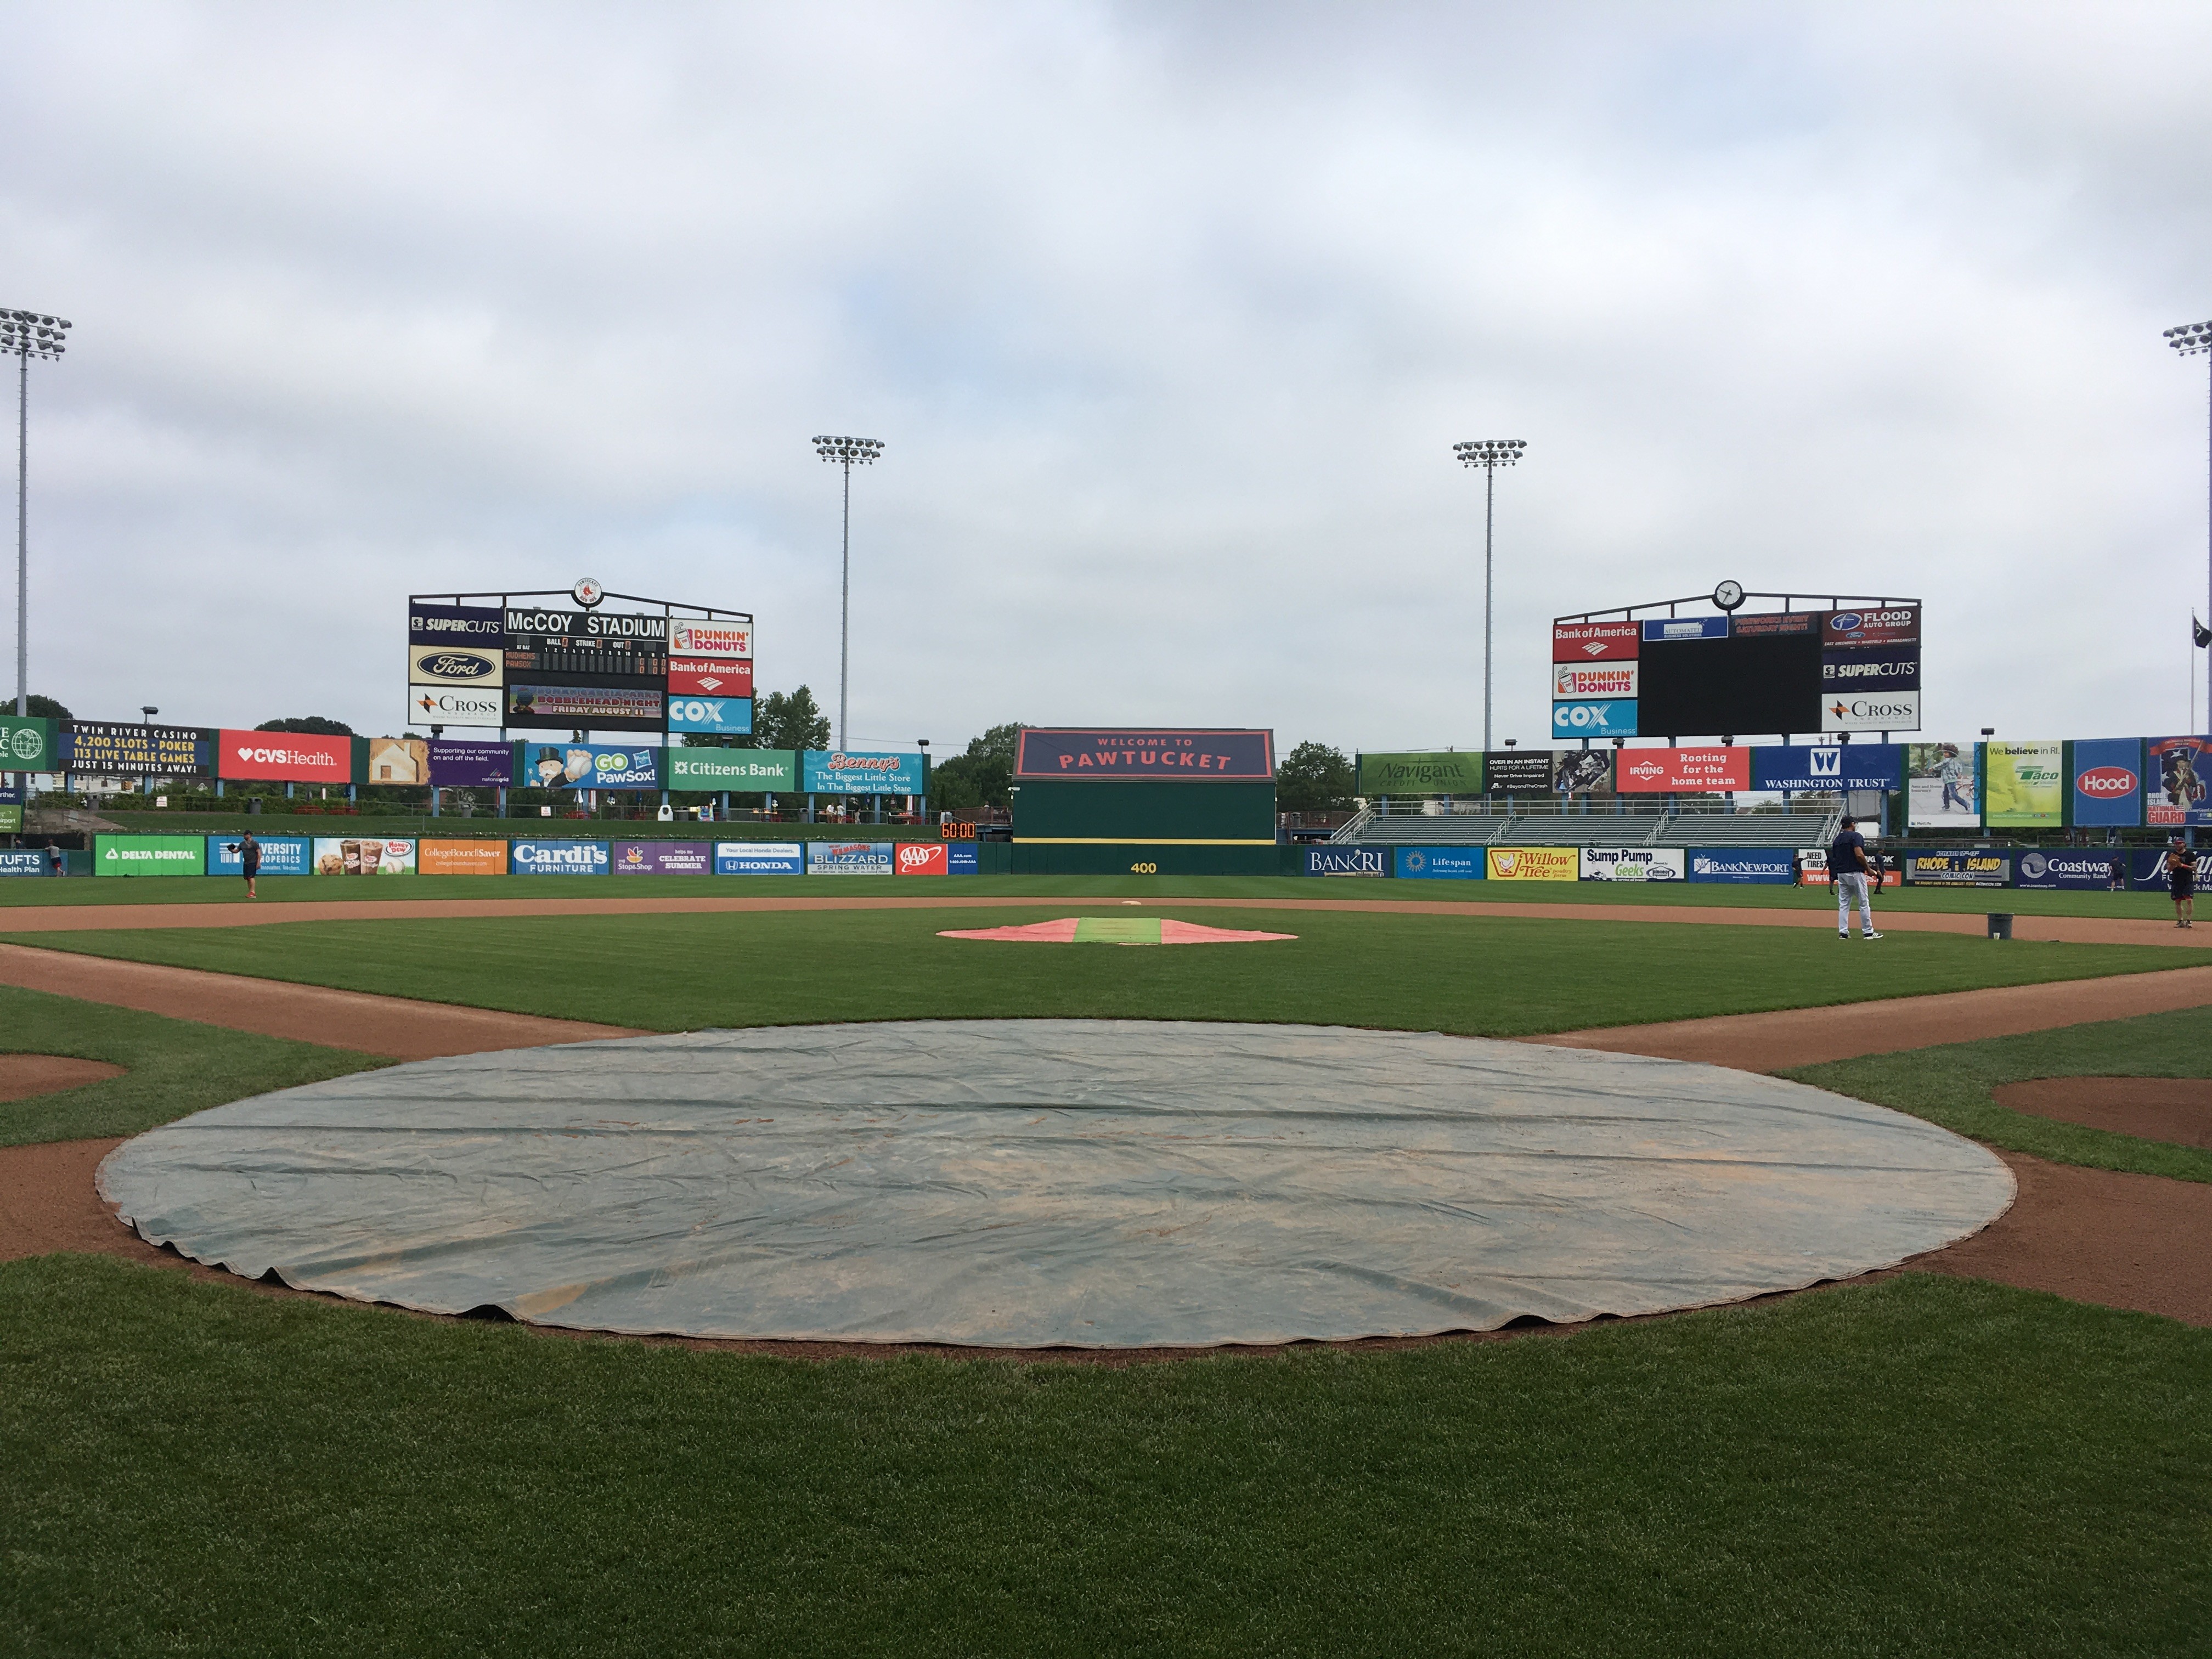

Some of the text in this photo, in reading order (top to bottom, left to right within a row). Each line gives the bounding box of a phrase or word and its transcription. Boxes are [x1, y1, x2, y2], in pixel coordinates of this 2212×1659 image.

[1864, 611, 1912, 622] FLOOD
[426, 618, 499, 634] SUPERCUTS
[507, 612, 665, 637] McCOY STADIUM
[694, 629, 749, 641] DUNKIN'
[1555, 626, 1637, 639] Bank of America
[546, 637, 561, 646] BALL
[575, 639, 596, 647] STRIKE
[694, 640, 746, 652] DONUTS
[433, 656, 480, 675] Ford
[670, 661, 751, 675] Bank of America
[1838, 662, 1915, 678] SUPERCUTS
[1578, 670, 1634, 682] DUNKIN'
[1578, 681, 1631, 692] DONUTS
[537, 696, 660, 707] BOBBLEHEAD NIGHT
[592, 707, 631, 715] AUGUST
[669, 700, 727, 725] COX
[1554, 703, 1612, 730] COX
[72, 725, 197, 740] TWIN RIVER CASINO
[715, 724, 750, 732] Business
[74, 736, 195, 752] 4,200 SLOTS POKER
[1098, 738, 1193, 746] WELCOME TO
[74, 748, 195, 764] 113 LIVE TABLE GAMES
[433, 747, 465, 755] Supporting
[2005, 747, 2039, 755] believe
[595, 753, 629, 771] GO
[827, 752, 900, 773] Benny's
[1058, 751, 1231, 770] PAWTUCKET
[1680, 753, 1727, 764] Rooting
[71, 760, 197, 774] JUST 15 MINUTES AWAY!
[690, 762, 785, 776] Citizens Bank
[1378, 763, 1465, 783] Navigant
[1629, 766, 1664, 775] IRVING
[1683, 764, 1724, 774] for the
[2015, 766, 2059, 780] Taco
[596, 769, 656, 784] PawSox!
[815, 771, 911, 782] The Biggest Little Store
[1671, 777, 1703, 785] home
[2085, 774, 2130, 791] Hood
[817, 782, 825, 790] In
[826, 782, 843, 791] The
[845, 783, 871, 793] Biggest
[873, 783, 891, 792] Little
[1765, 778, 1888, 788] WASHINGTON TRUST
[2148, 811, 2185, 823] GUARD
[941, 823, 975, 838] 60:00
[121, 850, 195, 860] DELTA DENTAL
[514, 844, 608, 864] Cardi's
[814, 854, 889, 864] BLIZZARD
[1519, 853, 1576, 866] Willow
[1587, 849, 1653, 865] Sump Pump
[1807, 851, 1822, 860] NEED
[530, 864, 594, 873] FURNITURE
[739, 862, 793, 870] HONDA
[1130, 862, 1157, 873] 400
[1432, 858, 1471, 867] Lifespan
[1916, 857, 2001, 871] RHODE ISLAND
[2048, 858, 2111, 877] Coastway
[1519, 865, 1550, 878] Tree
[1615, 863, 1645, 877] Geeks
